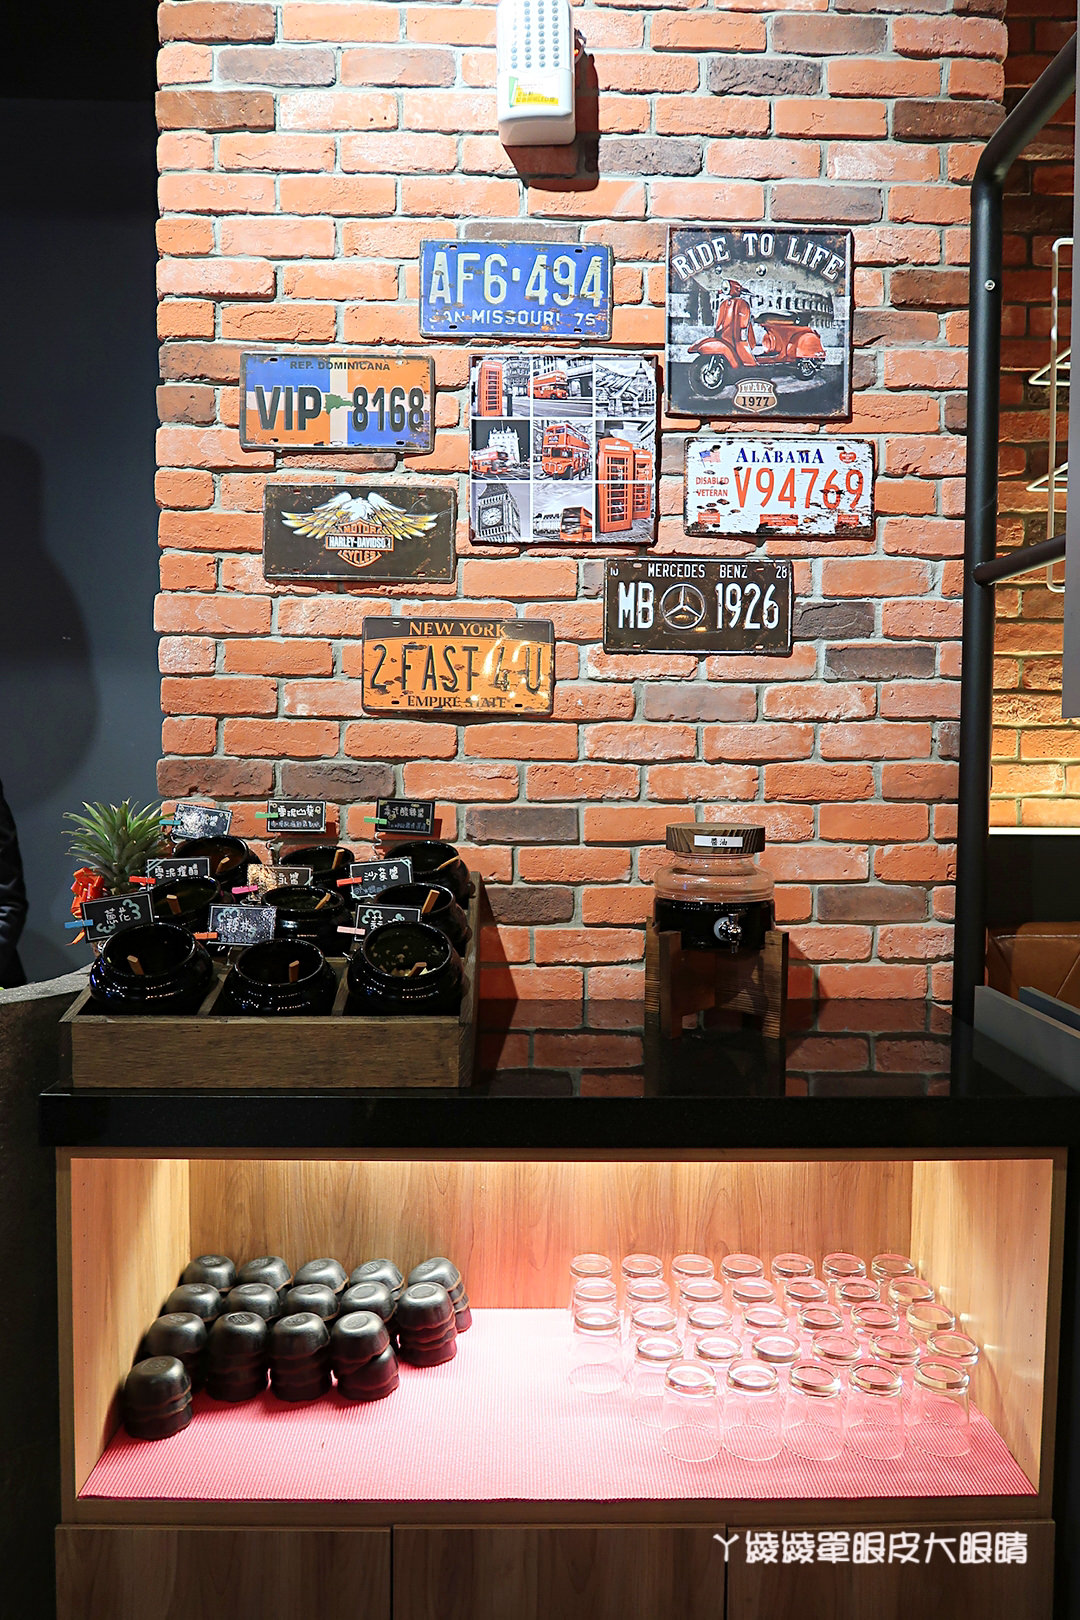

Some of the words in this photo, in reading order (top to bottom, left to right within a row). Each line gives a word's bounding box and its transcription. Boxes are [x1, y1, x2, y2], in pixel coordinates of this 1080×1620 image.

[672, 236, 730, 281] RIDE
[743, 232, 775, 257] TO
[786, 236, 845, 282] LIFE
[472, 309, 560, 326] MISSOURI
[290, 361, 314, 370] REP.
[318, 361, 391, 371] DOMINICANA
[740, 383, 772, 393] ITALY
[741, 396, 770, 407] 1977
[254, 385, 322, 431] VIP
[352, 386, 425, 433] 8168
[695, 477, 729, 485] DISABLED
[733, 467, 864, 509] V94769
[696, 489, 728, 497] VETERAN
[343, 522, 377, 534] MOTOR
[343, 550, 377, 564] CYCLES
[648, 564, 706, 578] MERCEDES
[719, 564, 748, 579] BENZ
[776, 565, 787, 578] 28
[618, 582, 655, 629] MB
[715, 582, 780, 630] 1926
[409, 622, 454, 636] NEW
[460, 623, 507, 638] YORK
[370, 644, 388, 691] 2
[401, 644, 479, 693] FAST
[407, 695, 461, 708] EMPIRE
[464, 696, 507, 708] STATE
